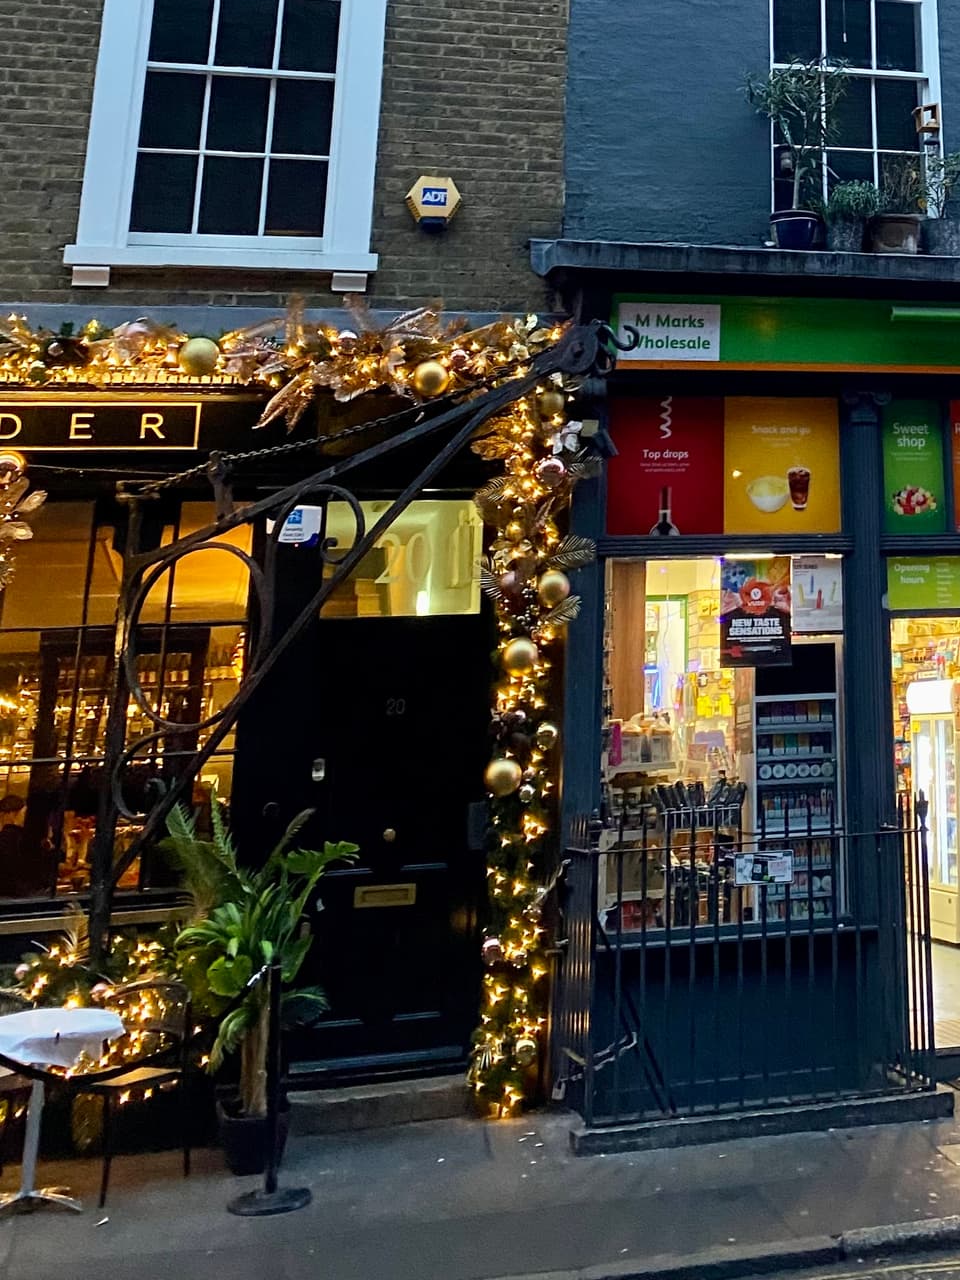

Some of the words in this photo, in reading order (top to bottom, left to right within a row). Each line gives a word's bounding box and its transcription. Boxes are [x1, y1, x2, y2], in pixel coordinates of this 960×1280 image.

[422, 188, 448, 206] ADT
[635, 314, 650, 327] M
[656, 314, 705, 328] Marks
[780, 425, 798, 434] and
[893, 422, 929, 435] Sweet
[897, 436, 926, 450] shop
[643, 449, 661, 460] Top
[662, 449, 689, 460] drops
[374, 533, 431, 584] 20
[894, 564, 930, 574] Opening
[900, 576, 925, 584] hours
[732, 618, 752, 626] NEW
[753, 618, 780, 626] TASTE
[729, 627, 782, 636] SENSATIONS
[386, 699, 406, 715] 20
